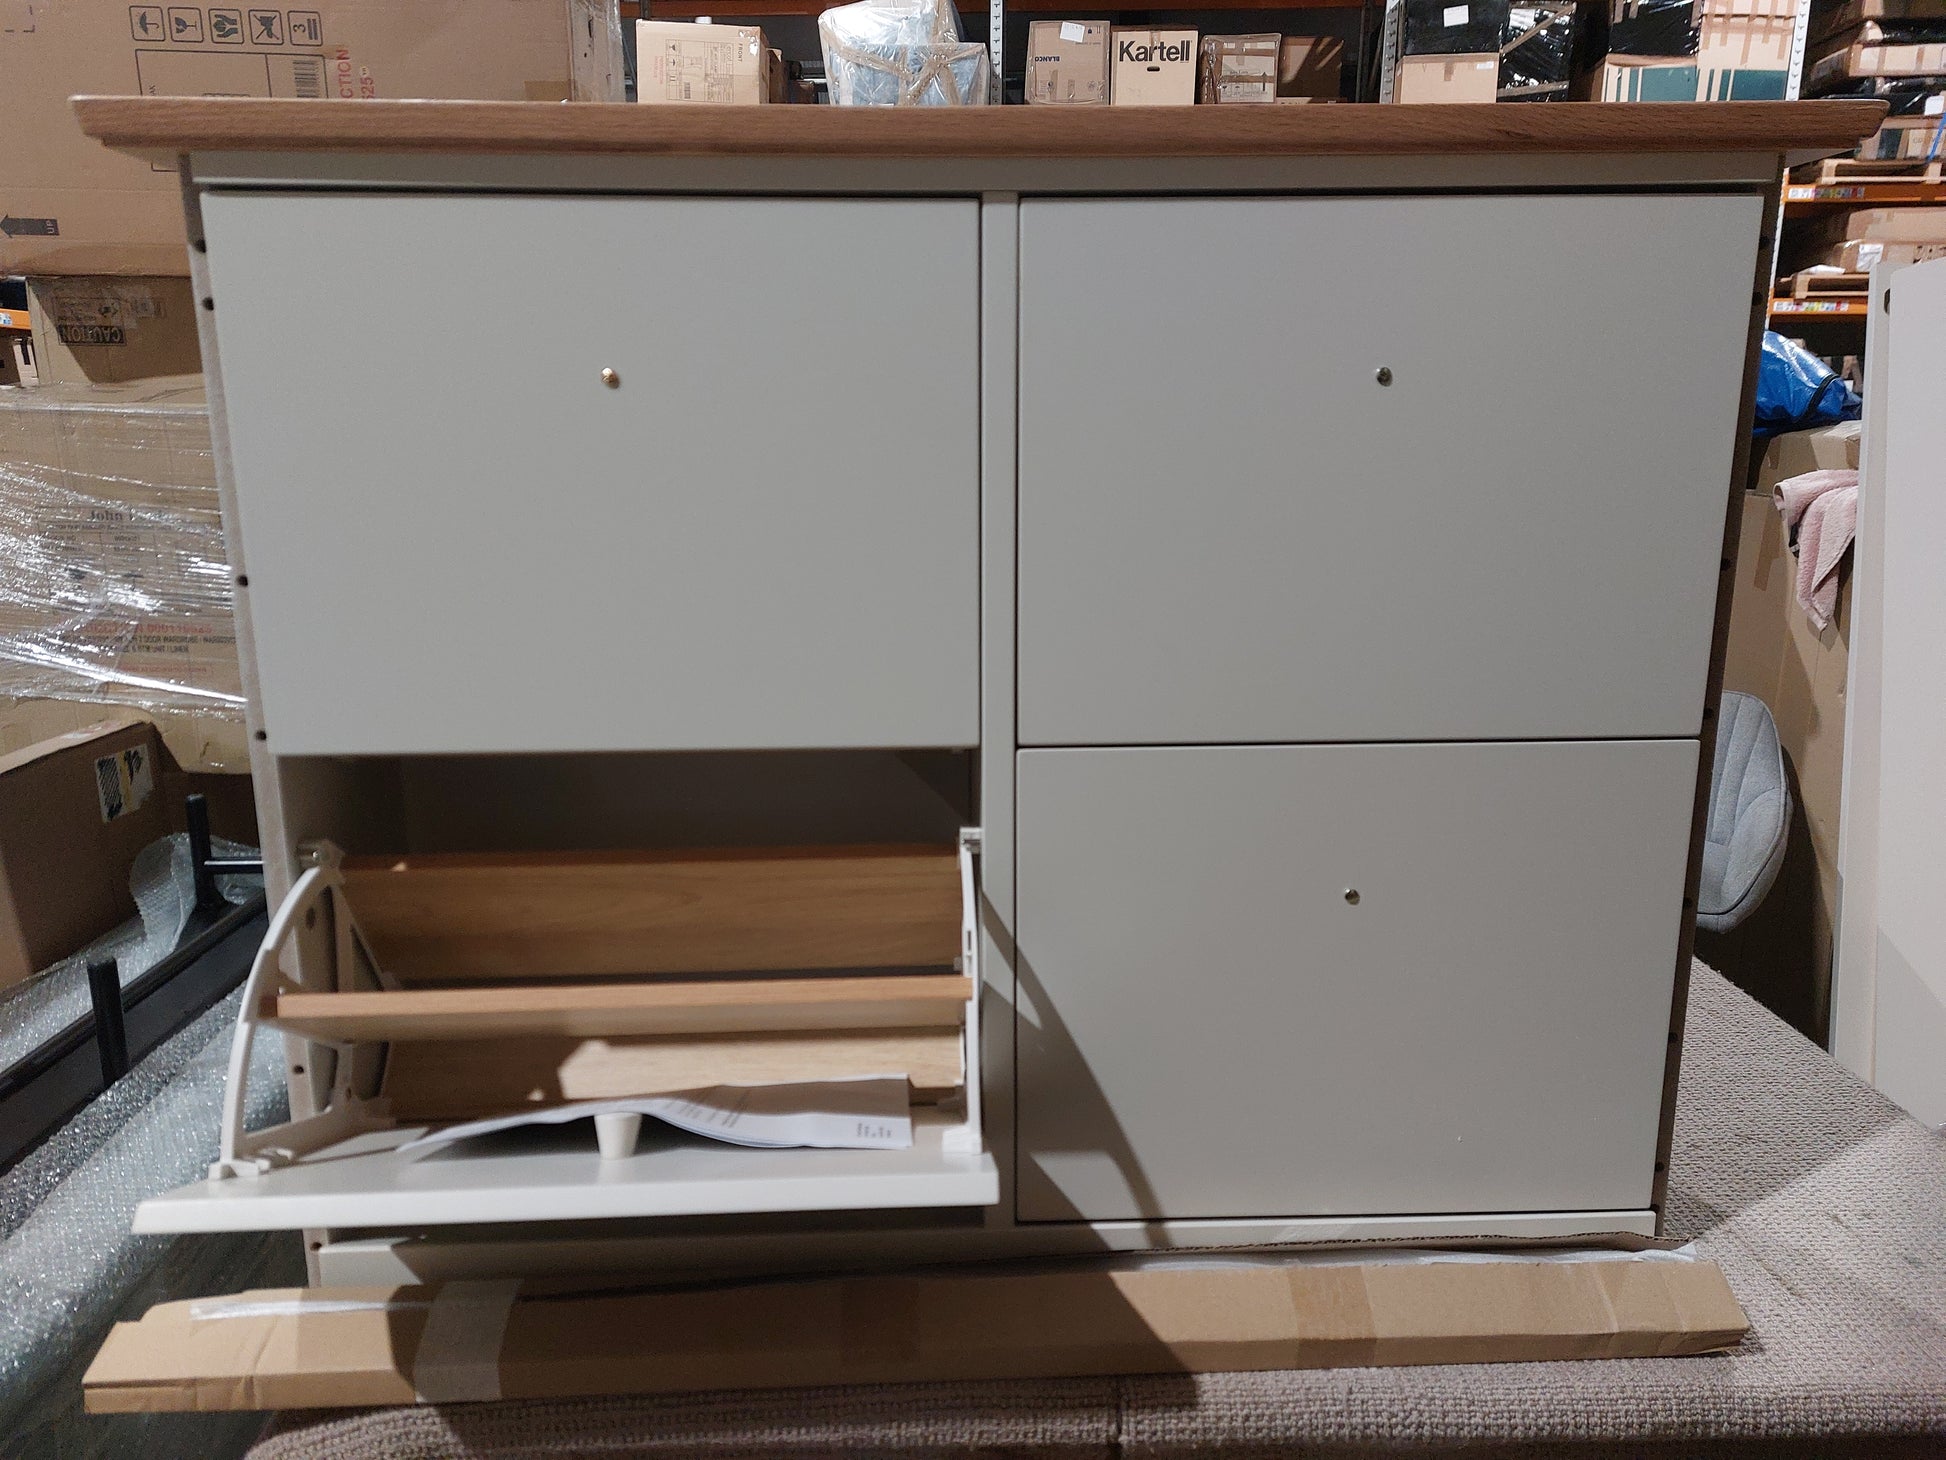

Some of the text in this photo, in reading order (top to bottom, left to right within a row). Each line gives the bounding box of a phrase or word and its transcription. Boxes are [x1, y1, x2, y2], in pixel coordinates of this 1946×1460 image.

[1119, 40, 1190, 62] Kartell
[46, 220, 55, 234] UP
[62, 326, 121, 343] CAUTION
[88, 510, 123, 521] John
